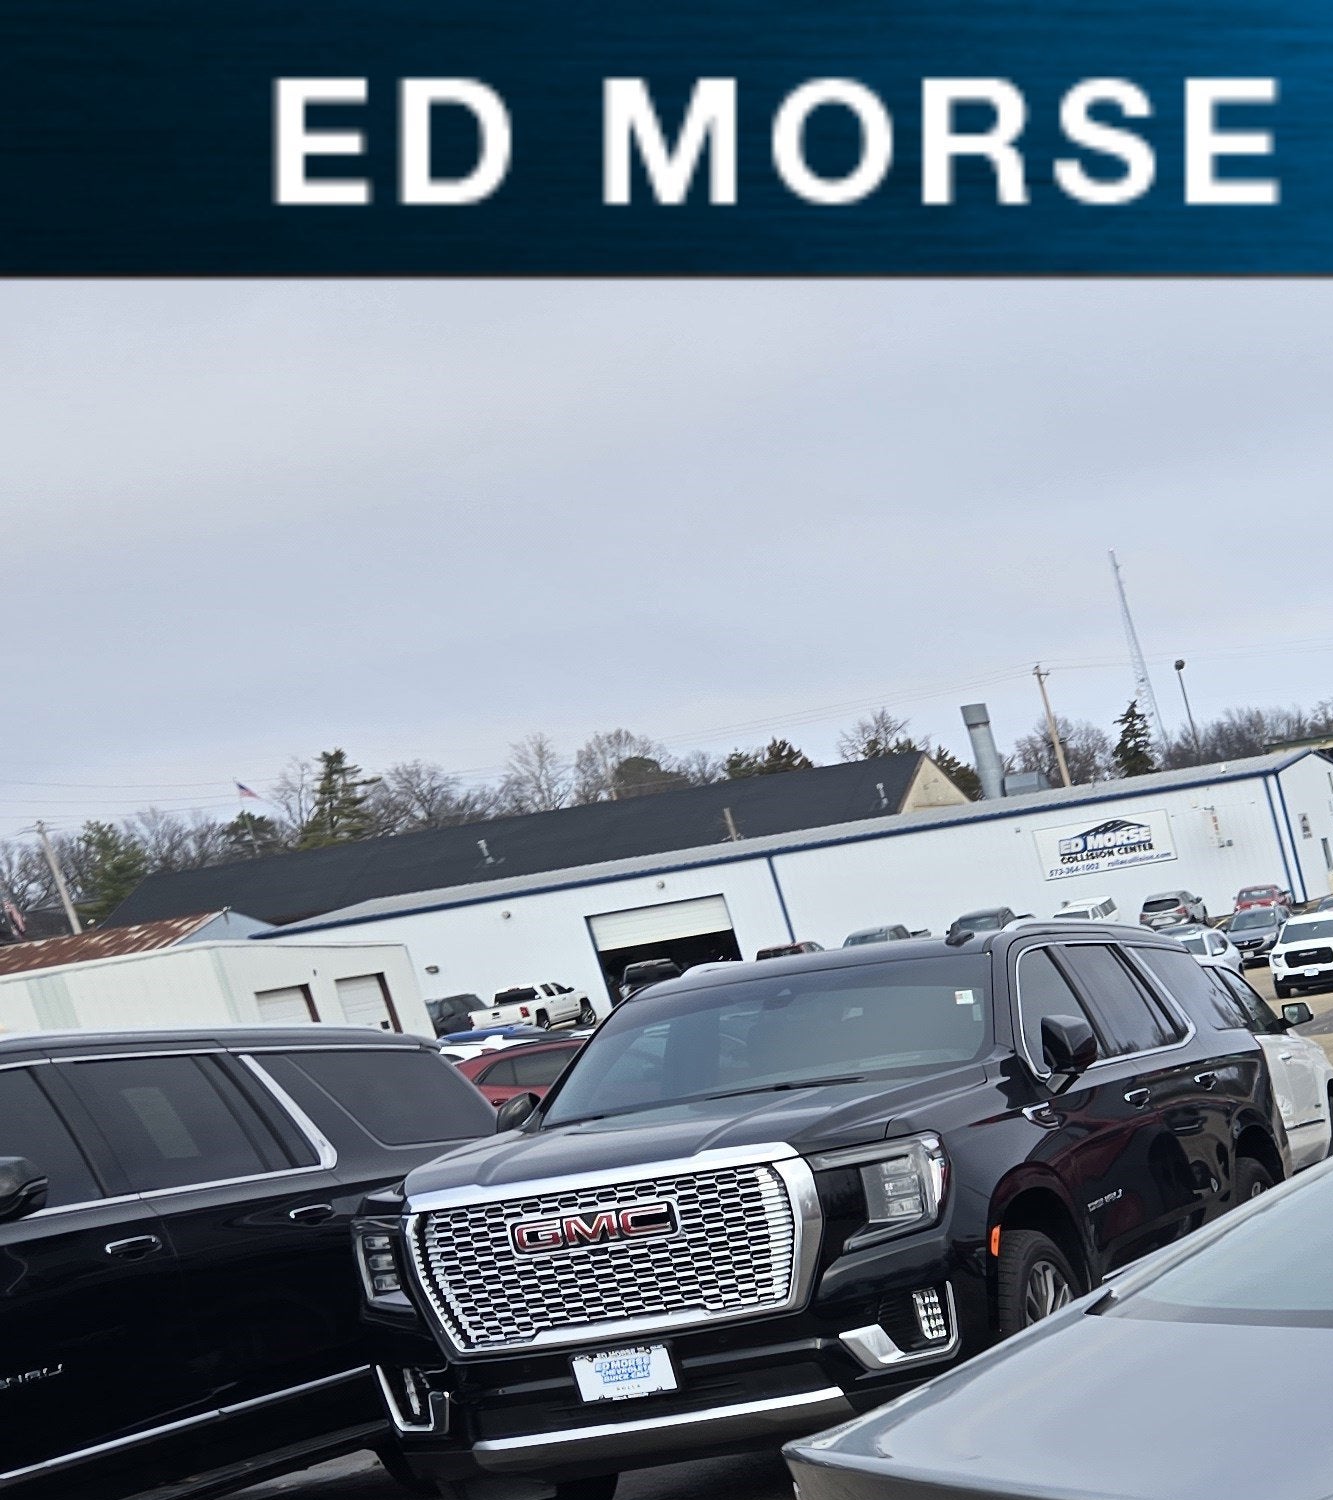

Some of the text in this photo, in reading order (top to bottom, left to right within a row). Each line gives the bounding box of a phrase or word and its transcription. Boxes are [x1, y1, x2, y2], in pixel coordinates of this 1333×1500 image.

[1059, 825, 1152, 856] ED MORSE
[1060, 842, 1154, 865] COLLISION CENTER
[514, 1203, 674, 1253] GMC
[611, 1356, 651, 1370] MORSE
